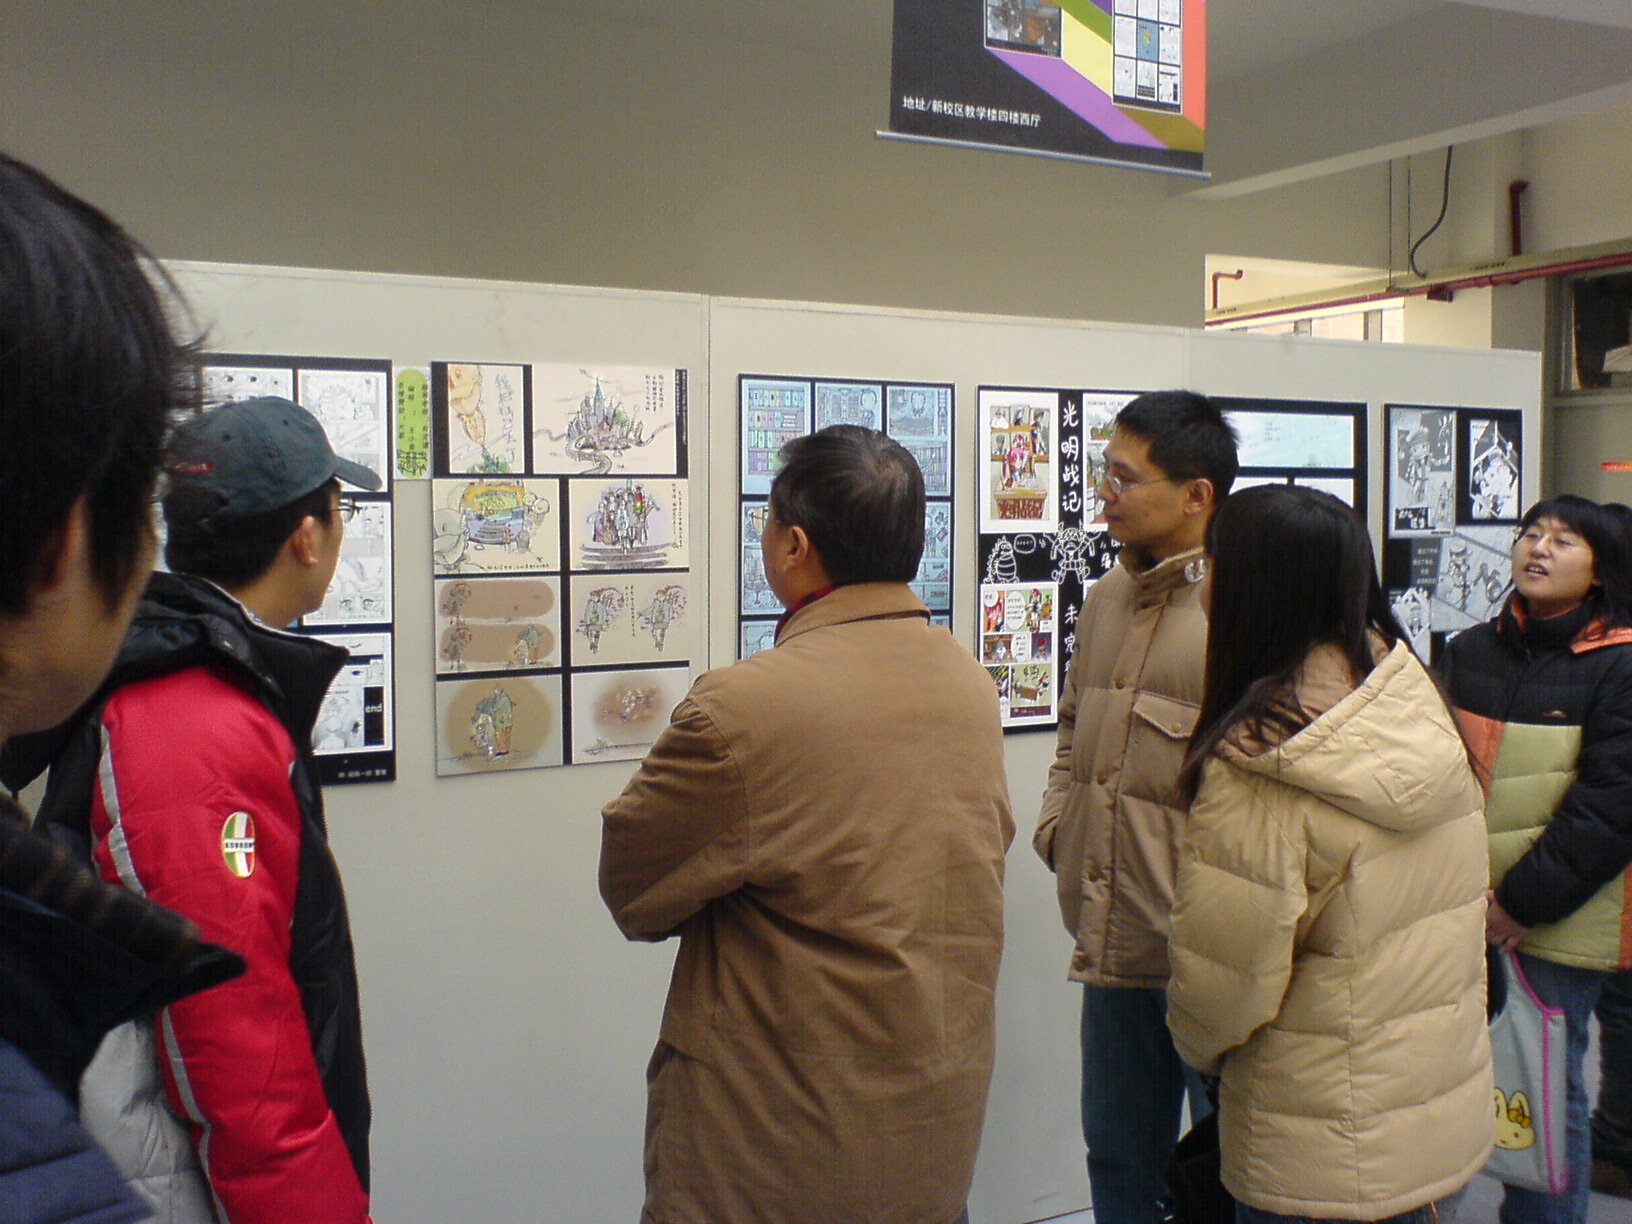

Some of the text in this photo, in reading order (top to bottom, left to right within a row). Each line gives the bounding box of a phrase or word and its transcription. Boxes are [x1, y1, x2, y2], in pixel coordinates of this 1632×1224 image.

[1061, 400, 1081, 512] 光明战记
[365, 702, 383, 713] end
